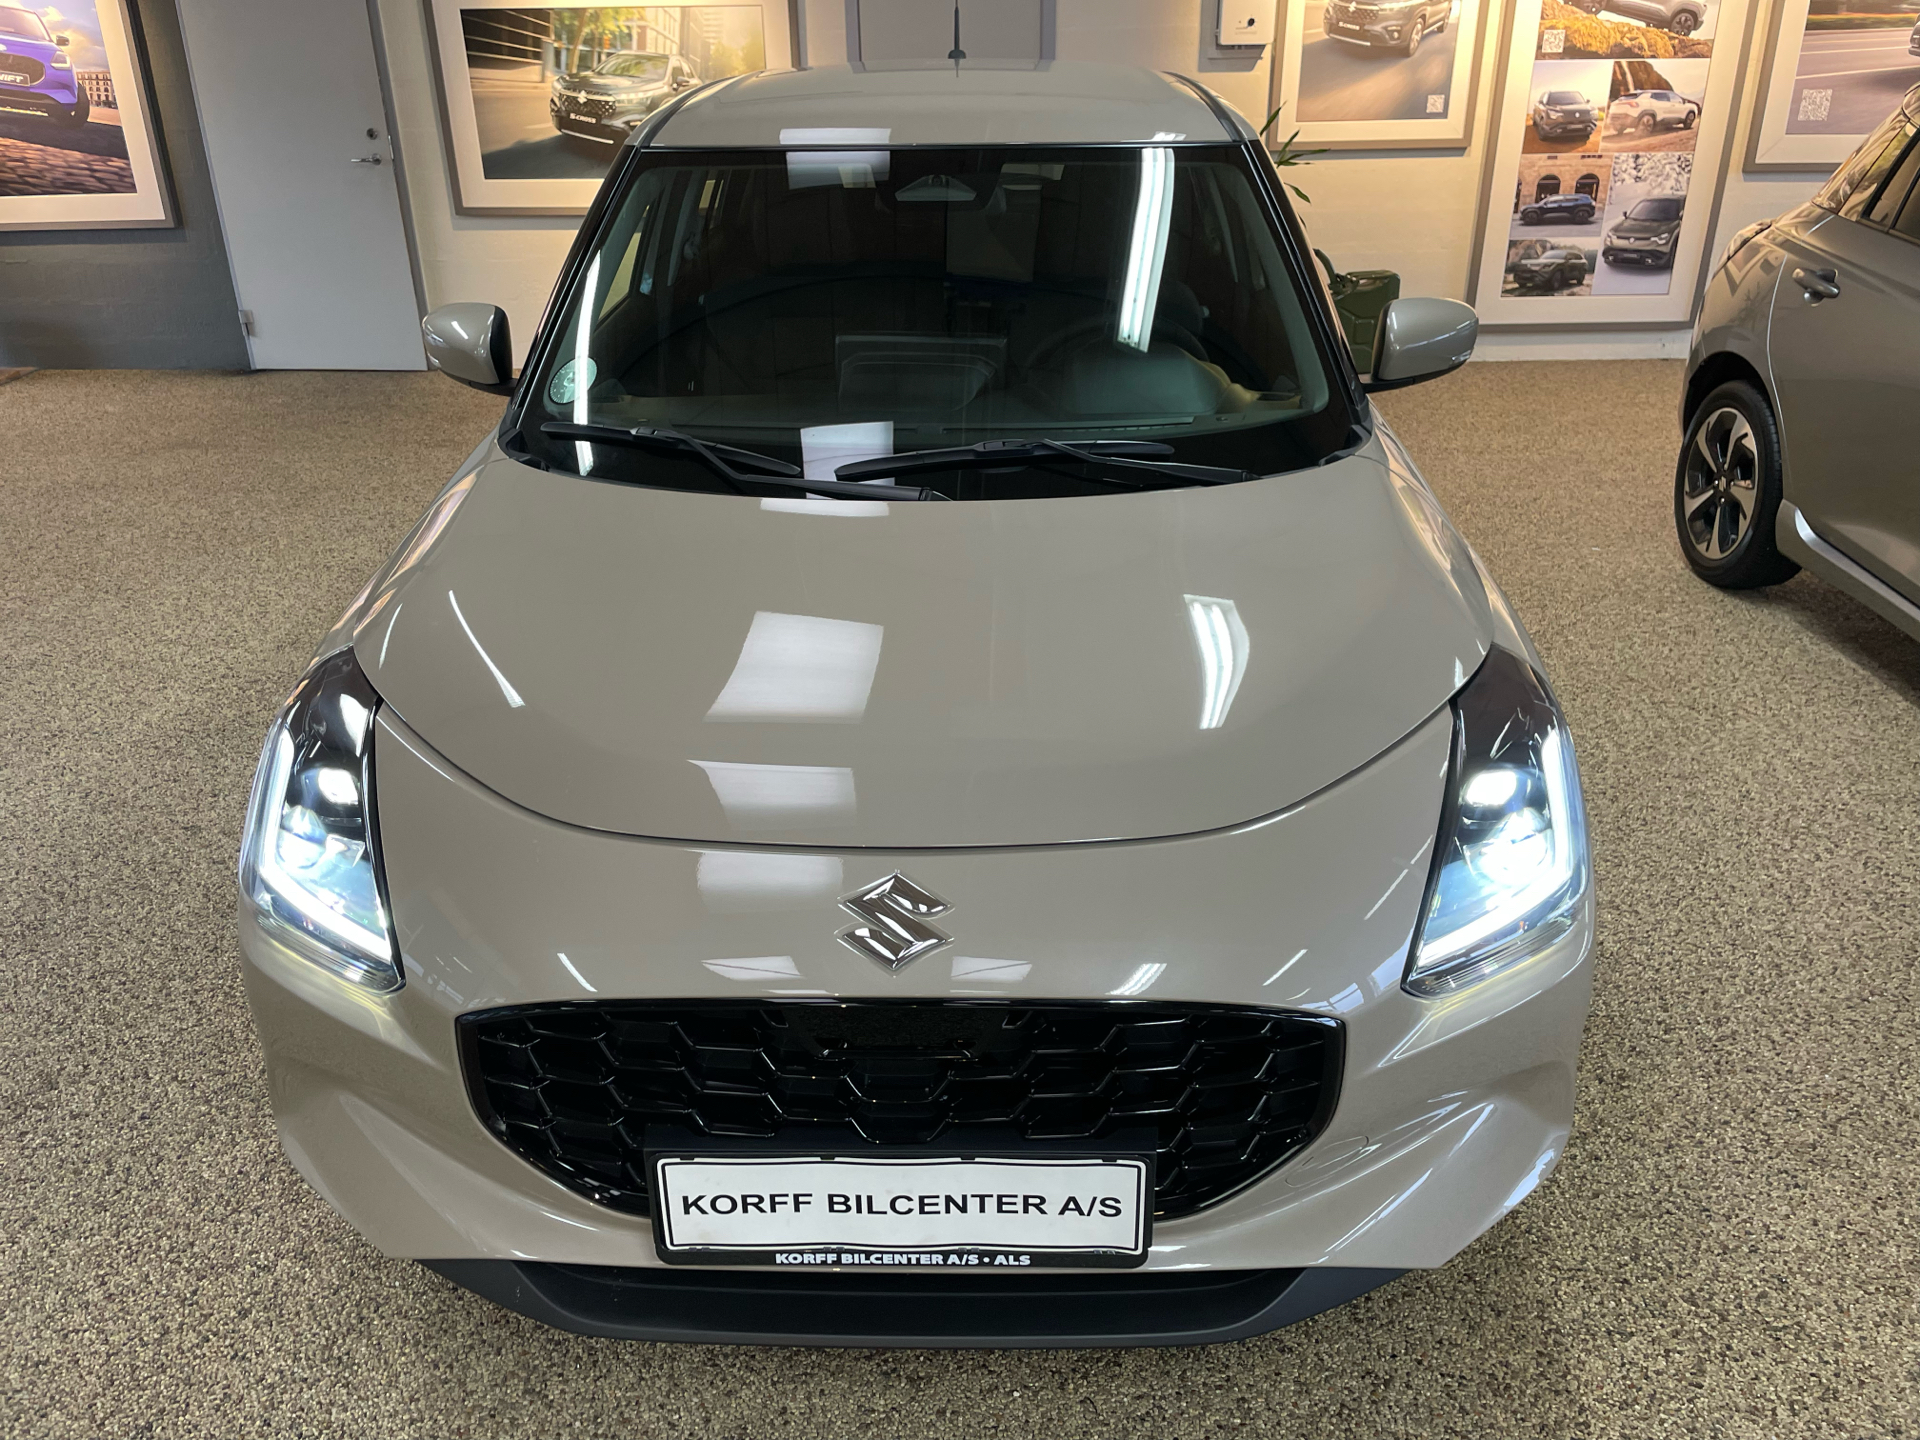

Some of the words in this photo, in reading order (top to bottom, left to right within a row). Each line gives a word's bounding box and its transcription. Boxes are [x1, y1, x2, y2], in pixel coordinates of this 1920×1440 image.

[681, 1193, 813, 1216] KORFF
[827, 1193, 1048, 1216] BILCENTER
[1057, 1196, 1123, 1218] A/S
[775, 1252, 838, 1265] KORFF
[841, 1253, 944, 1266] BILCENTER
[946, 1254, 979, 1266] A/S
[993, 1254, 1031, 1266] ALS
